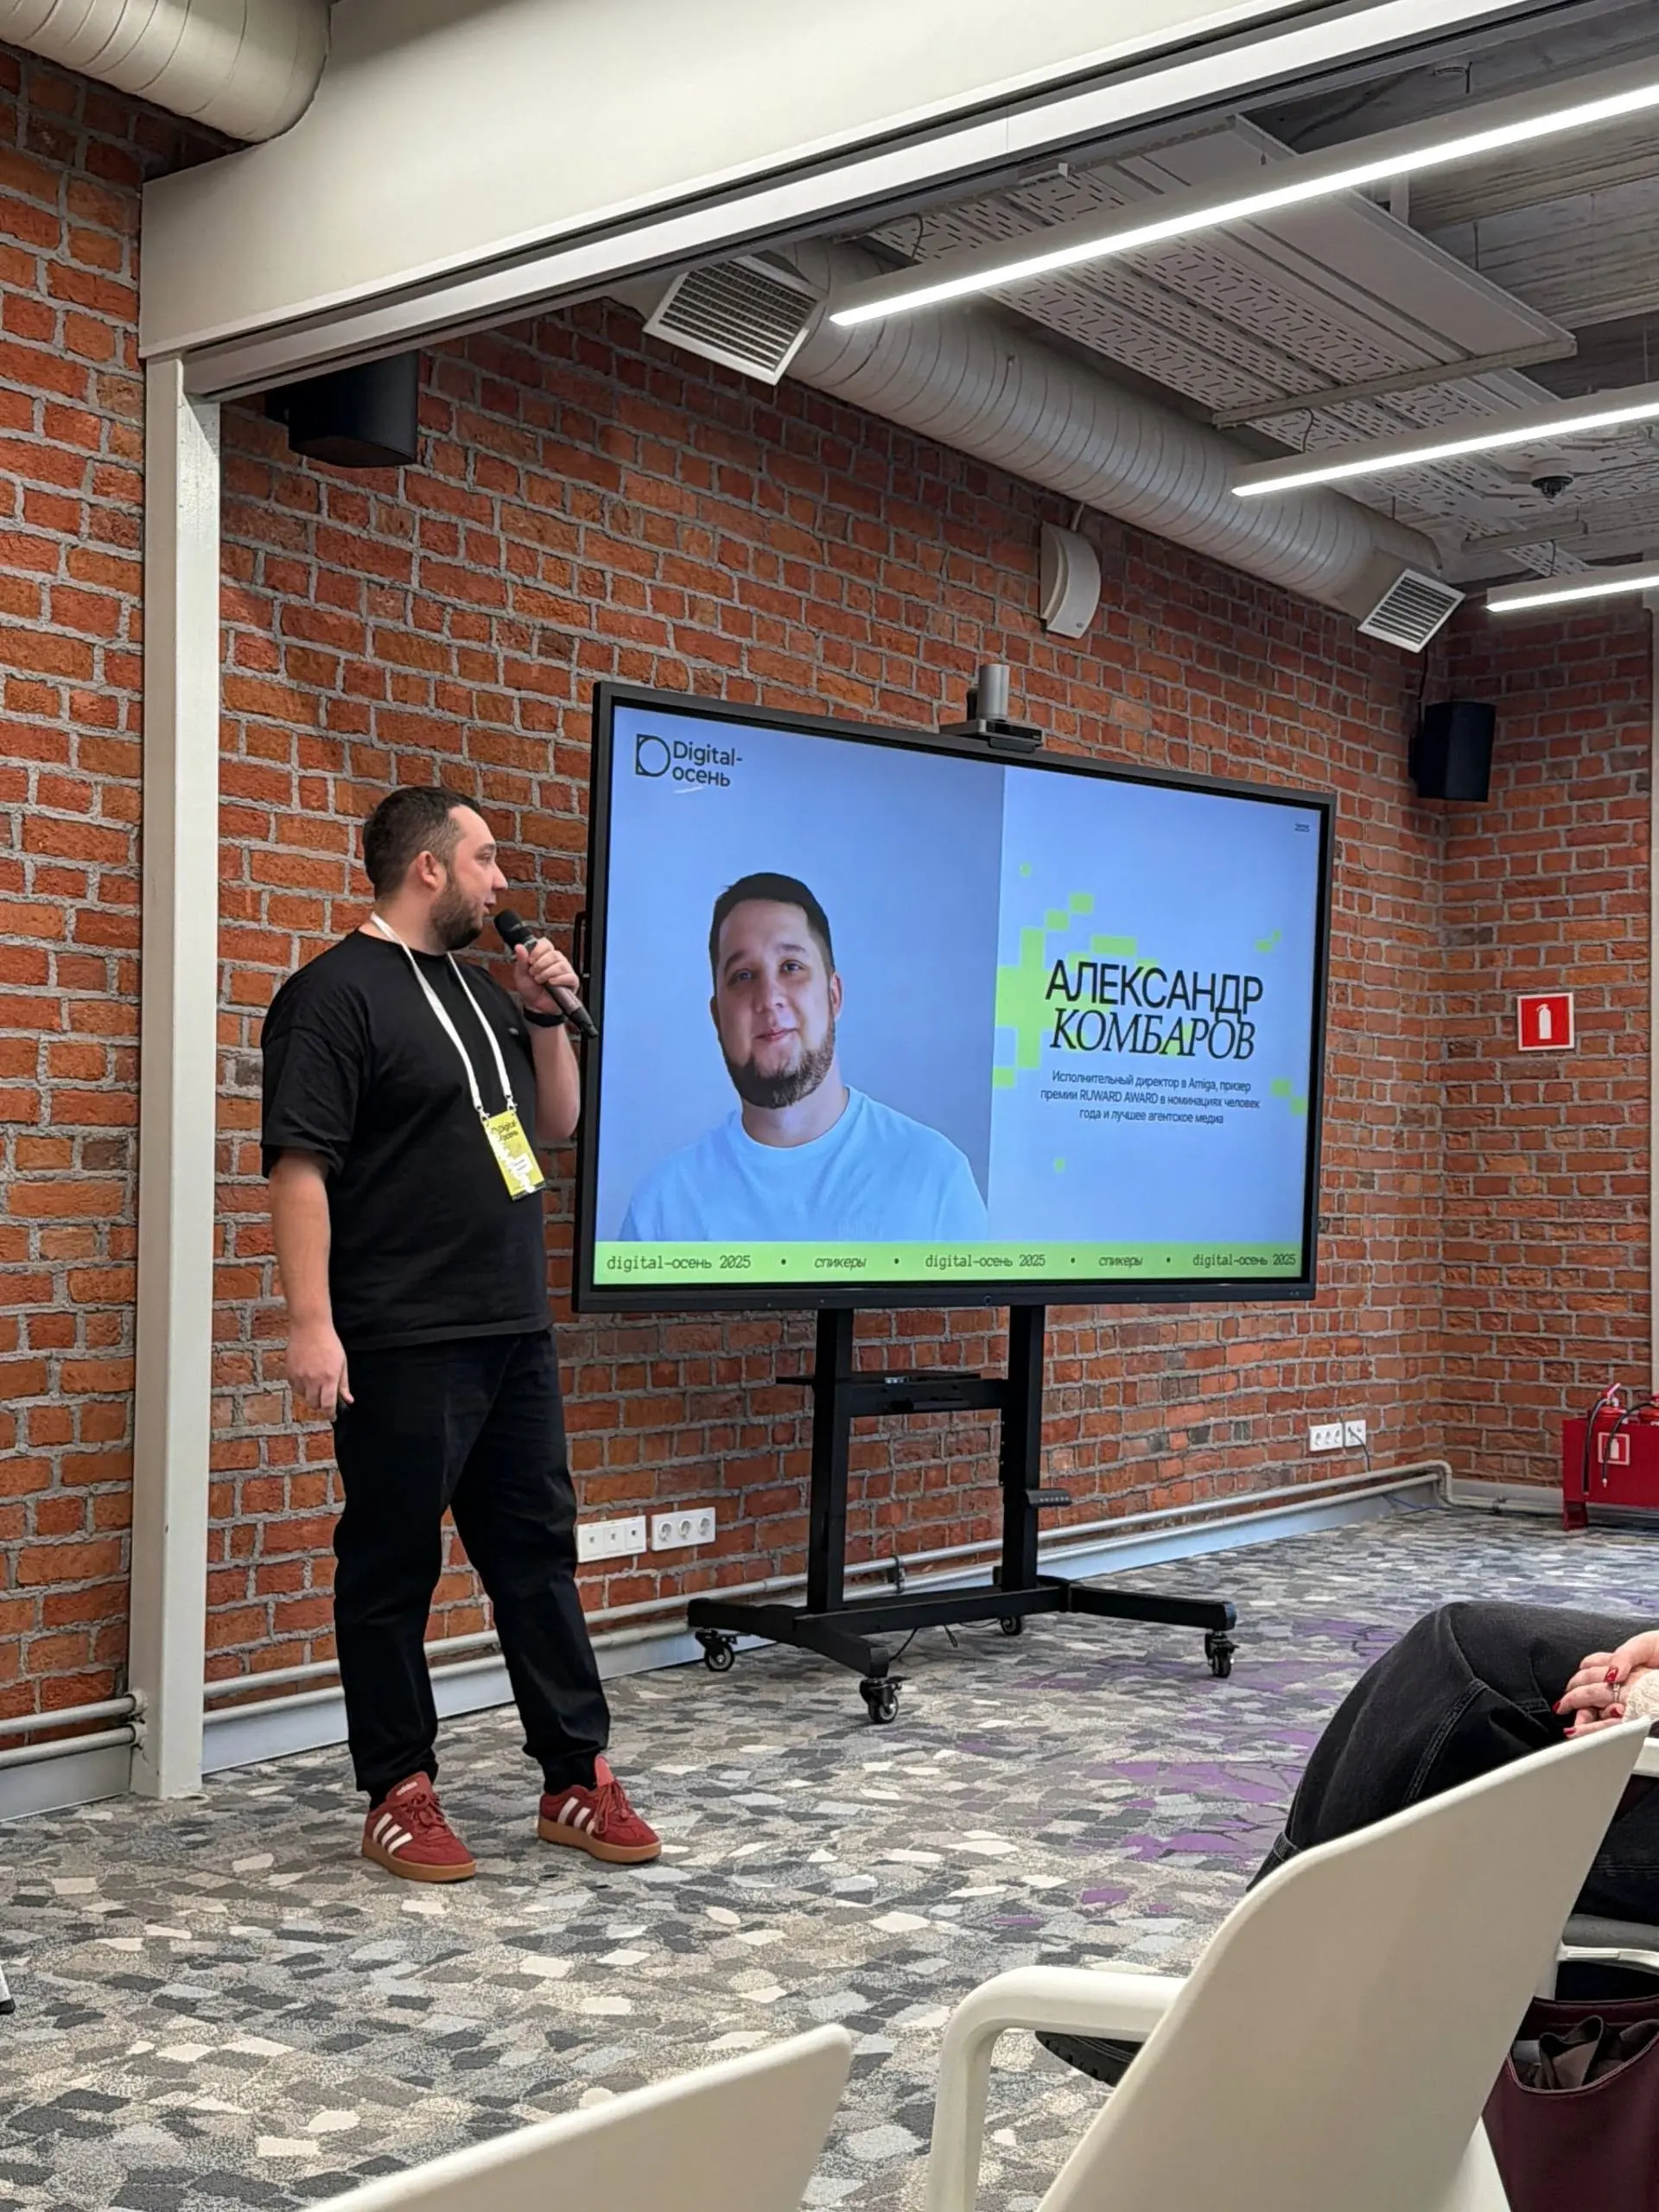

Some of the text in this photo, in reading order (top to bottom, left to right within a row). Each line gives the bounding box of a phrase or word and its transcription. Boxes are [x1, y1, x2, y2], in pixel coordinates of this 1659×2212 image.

[673, 741, 743, 766] Digital-
[672, 766, 730, 787] осень
[1045, 959, 1263, 1023] АЛЕКСАНДР
[1049, 1007, 1255, 1059] КОМБАРОВ
[1052, 1070, 1251, 1094] Исполнительный директор в Amiga, призер
[1040, 1089, 1261, 1109] премии RUWARD AWARD в номинациях человек
[1079, 1109, 1224, 1125] года и лучшее агентское медиа
[607, 1255, 712, 1273] digital-осень
[719, 1255, 751, 1269] 2025
[814, 1256, 867, 1271] спикеры
[925, 1255, 1014, 1270] digital-осень
[1019, 1254, 1046, 1267] 2025
[1098, 1255, 1143, 1268] спикеры
[1272, 1253, 1296, 1266] 2025
